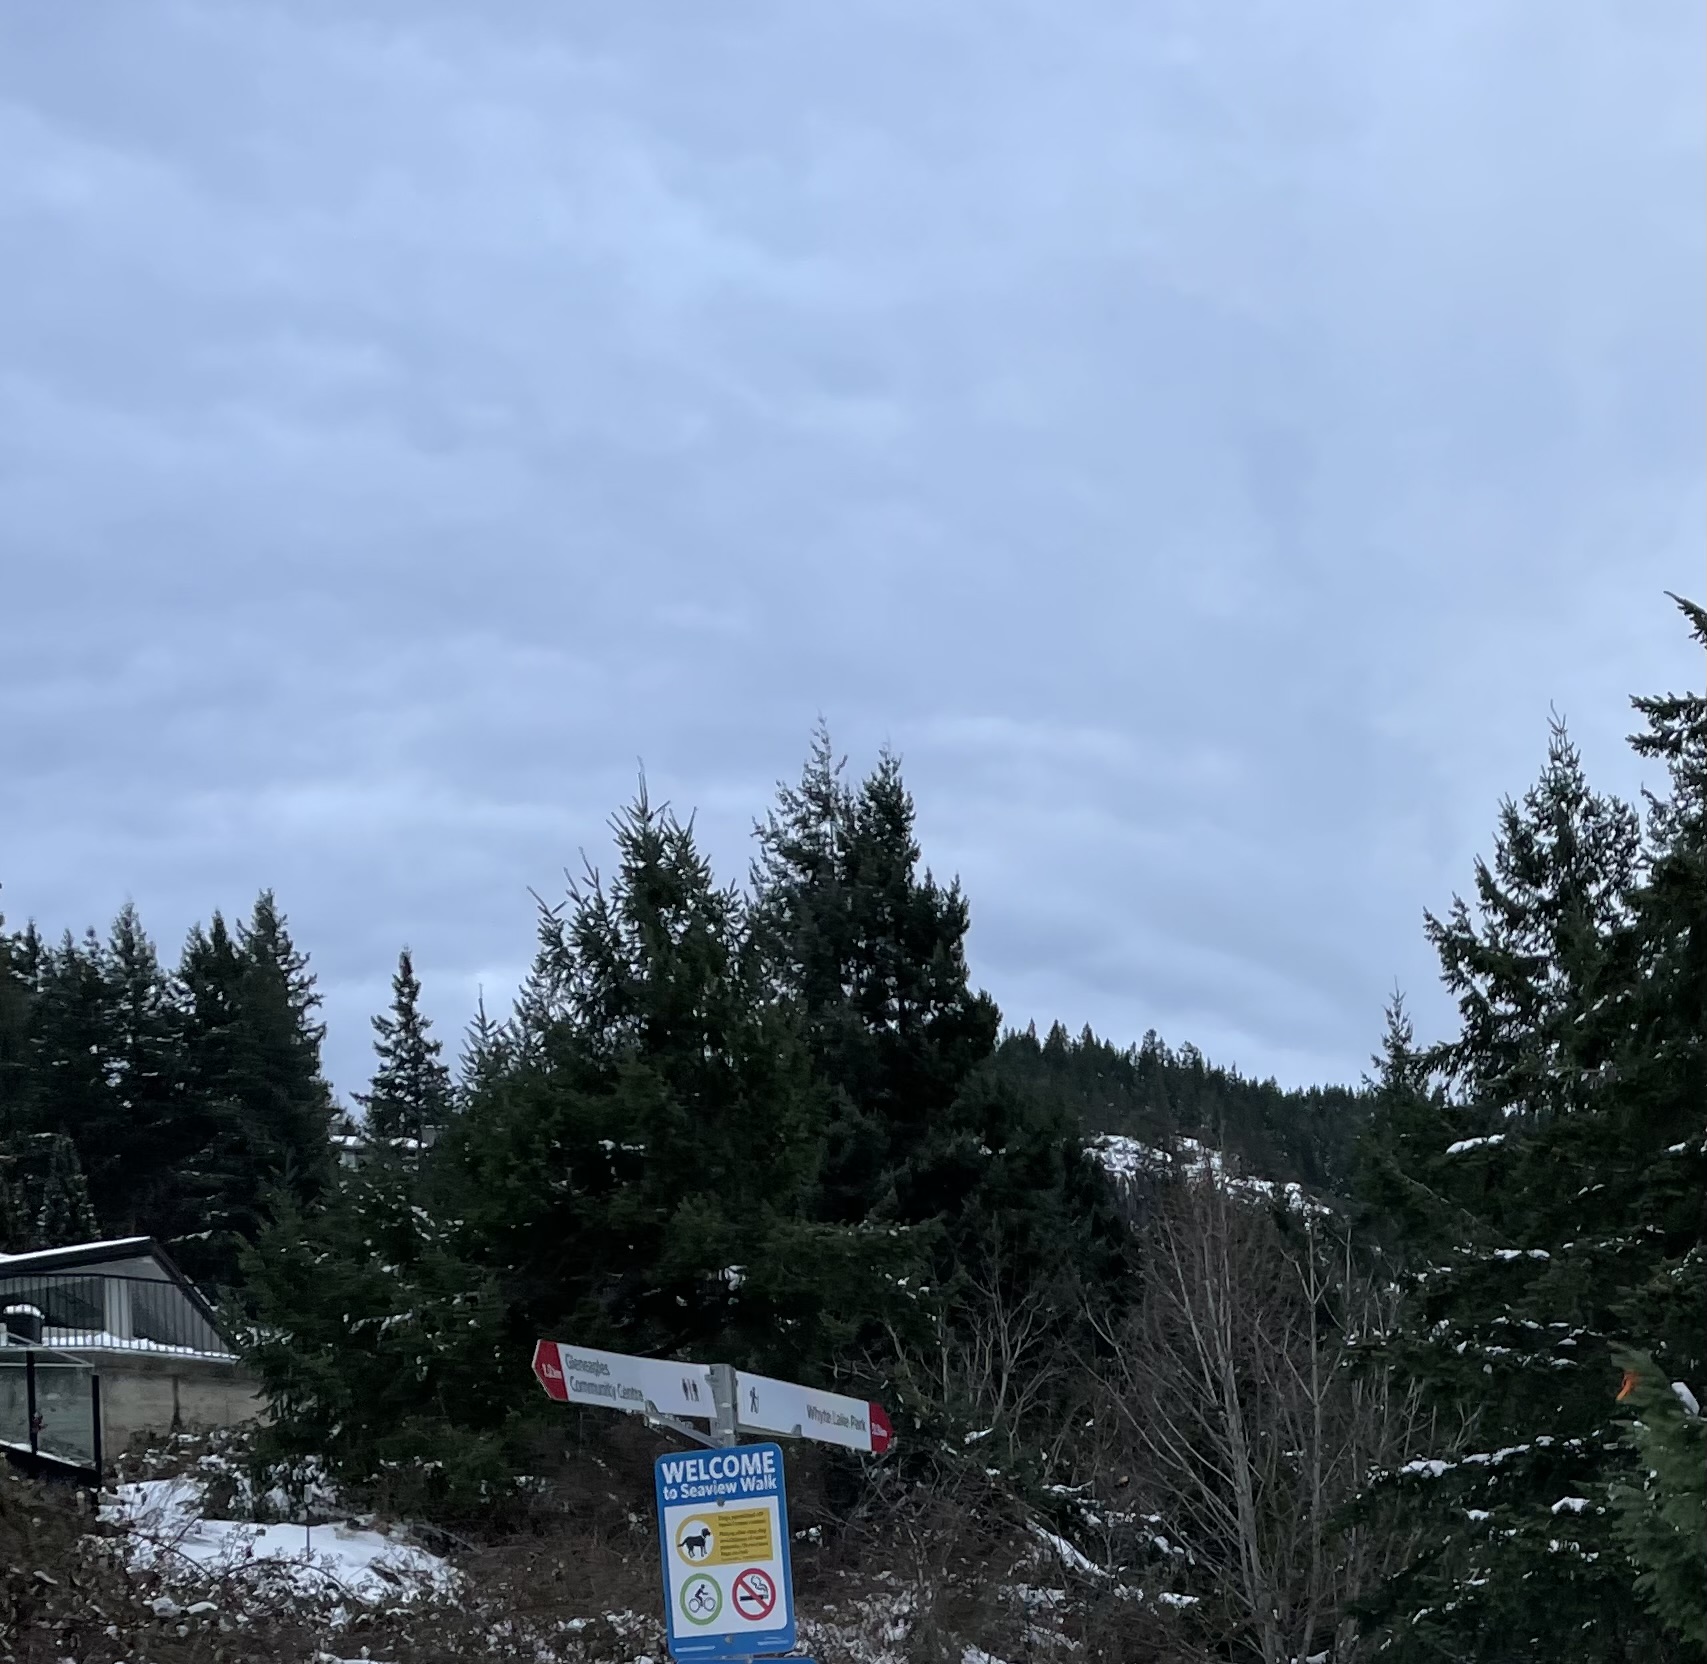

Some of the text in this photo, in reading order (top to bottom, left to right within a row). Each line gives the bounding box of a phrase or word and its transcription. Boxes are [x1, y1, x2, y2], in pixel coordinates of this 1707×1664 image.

[569, 1376, 617, 1401] Community
[850, 1414, 867, 1432] Park
[661, 1451, 776, 1484] WELCOME
[663, 1474, 777, 1500] to Seaview Walk
